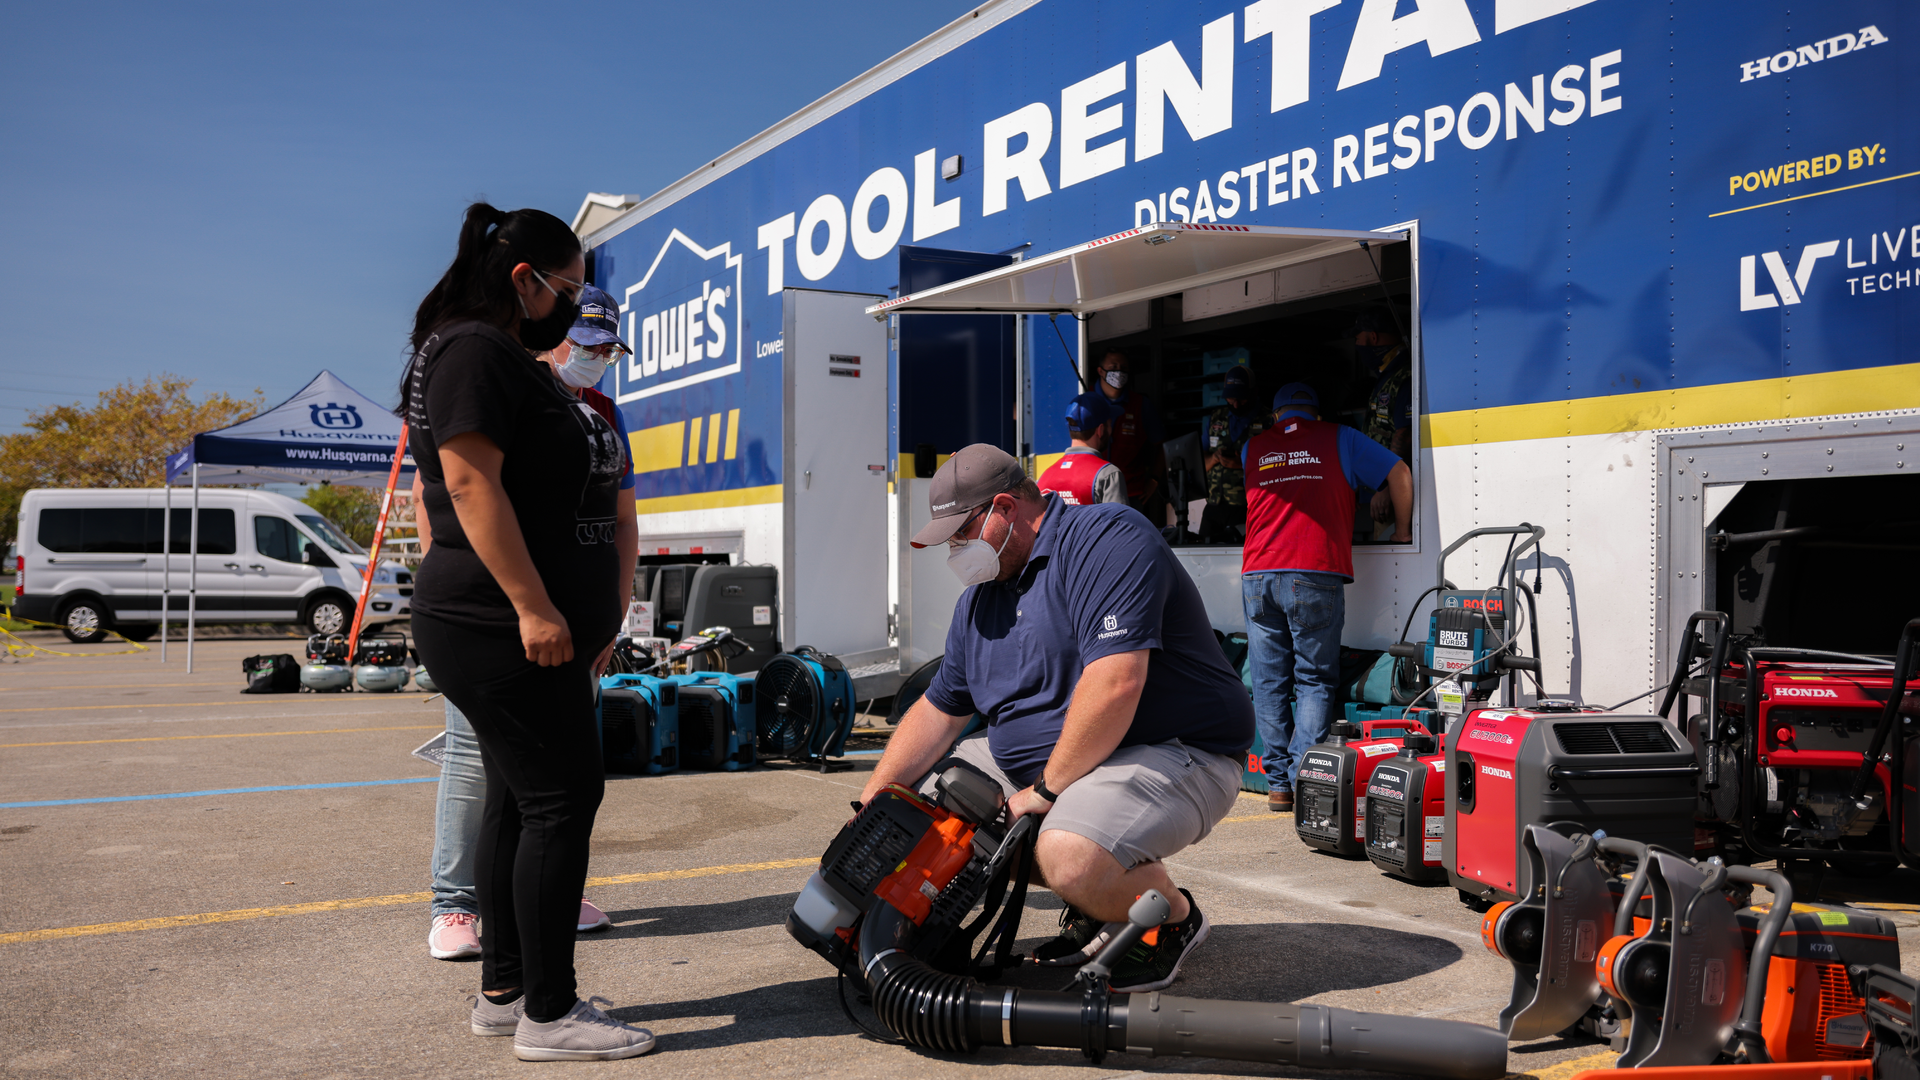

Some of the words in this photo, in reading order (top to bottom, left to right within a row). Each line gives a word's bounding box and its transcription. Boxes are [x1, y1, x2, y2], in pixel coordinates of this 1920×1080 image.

[1739, 24, 1888, 83] HONDA
[1135, 146, 1320, 229] DISASTER
[1332, 49, 1622, 188] RESPONSE
[757, 147, 961, 296] TOOL
[982, 0, 1598, 217] RENTA
[1729, 151, 1842, 196] POWERED
[1847, 143, 1887, 170] BY:
[1740, 239, 1840, 312] LV
[628, 280, 727, 382] LOWE'S
[285, 447, 414, 464] www.Husqvarna.cm
[1288, 450, 1310, 459] TOOL
[1288, 457, 1322, 466] RENTAL
[1098, 628, 1128, 640] Husqvarna
[1440, 630, 1469, 640] BRUTE
[1442, 639, 1466, 647] TURBO
[1774, 687, 1838, 698] HONDA
[1308, 757, 1332, 767] HONDA
[1377, 772, 1400, 783] HONDA
[1481, 765, 1513, 780] HONDA
[1836, 1022, 1864, 1032] Husqvarna
